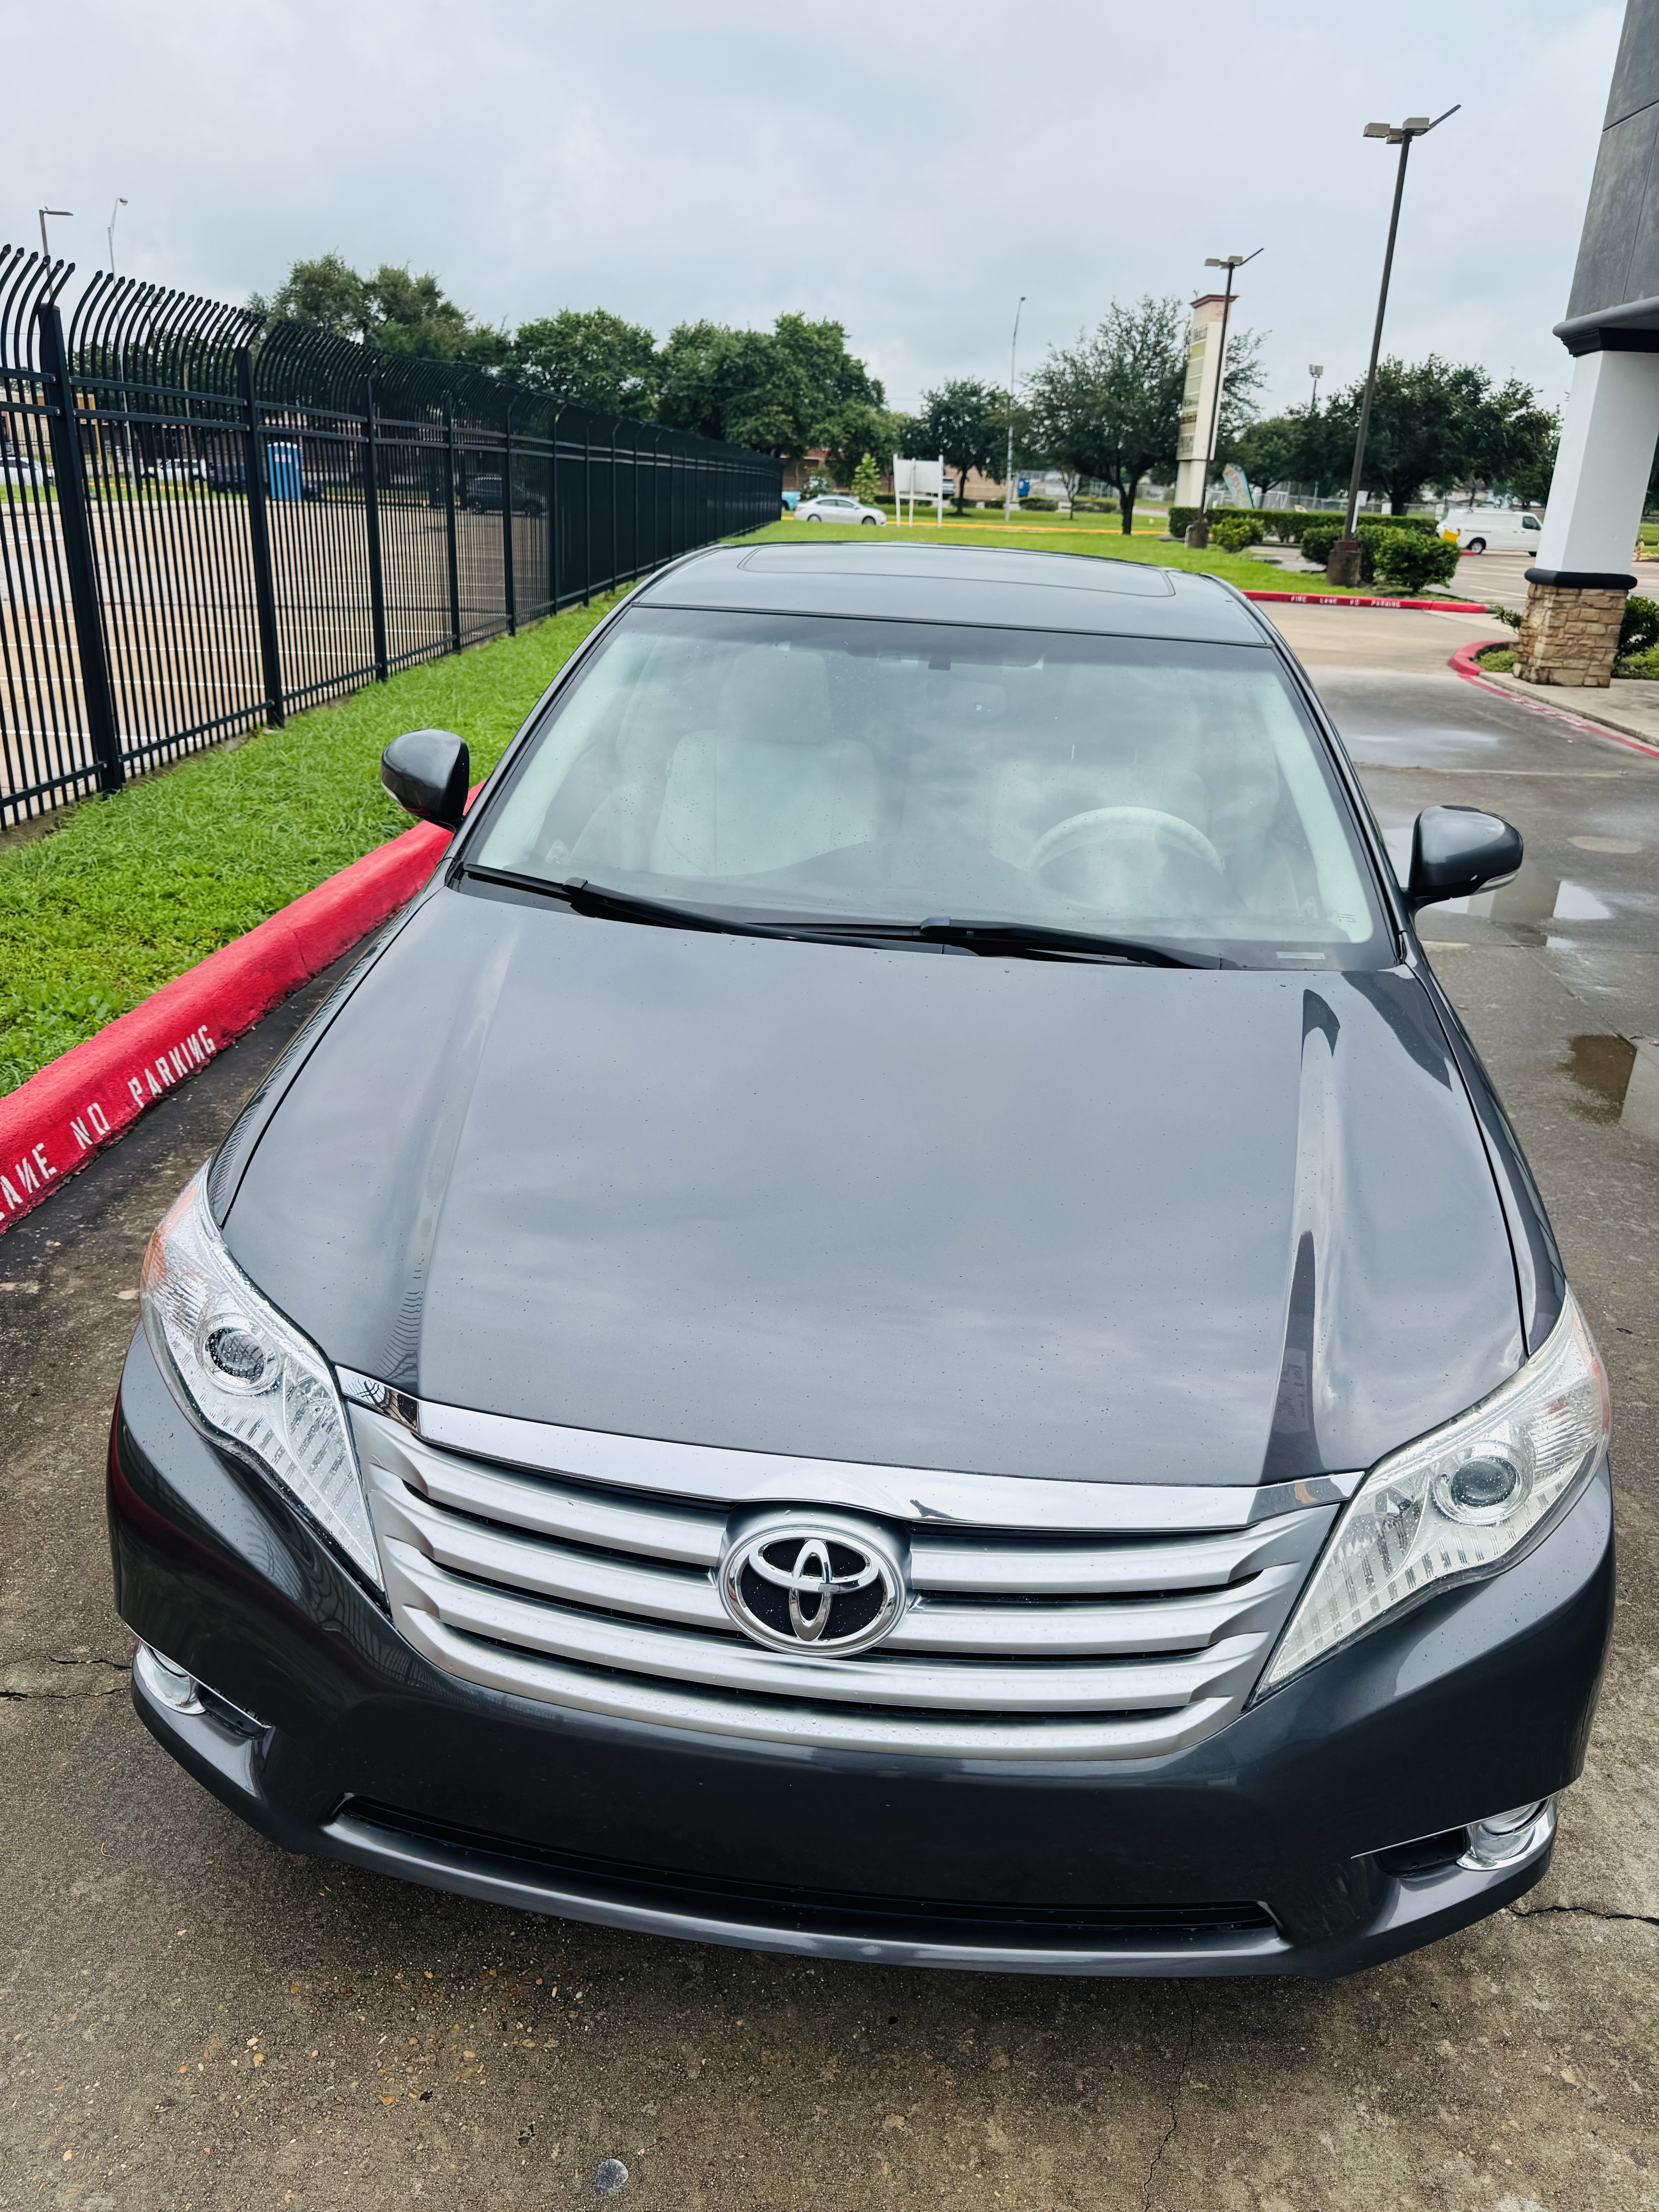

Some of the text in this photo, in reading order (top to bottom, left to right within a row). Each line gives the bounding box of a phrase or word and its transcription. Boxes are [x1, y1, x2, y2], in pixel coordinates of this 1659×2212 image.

[0, 1025, 216, 1221] ANE NO PARKING
